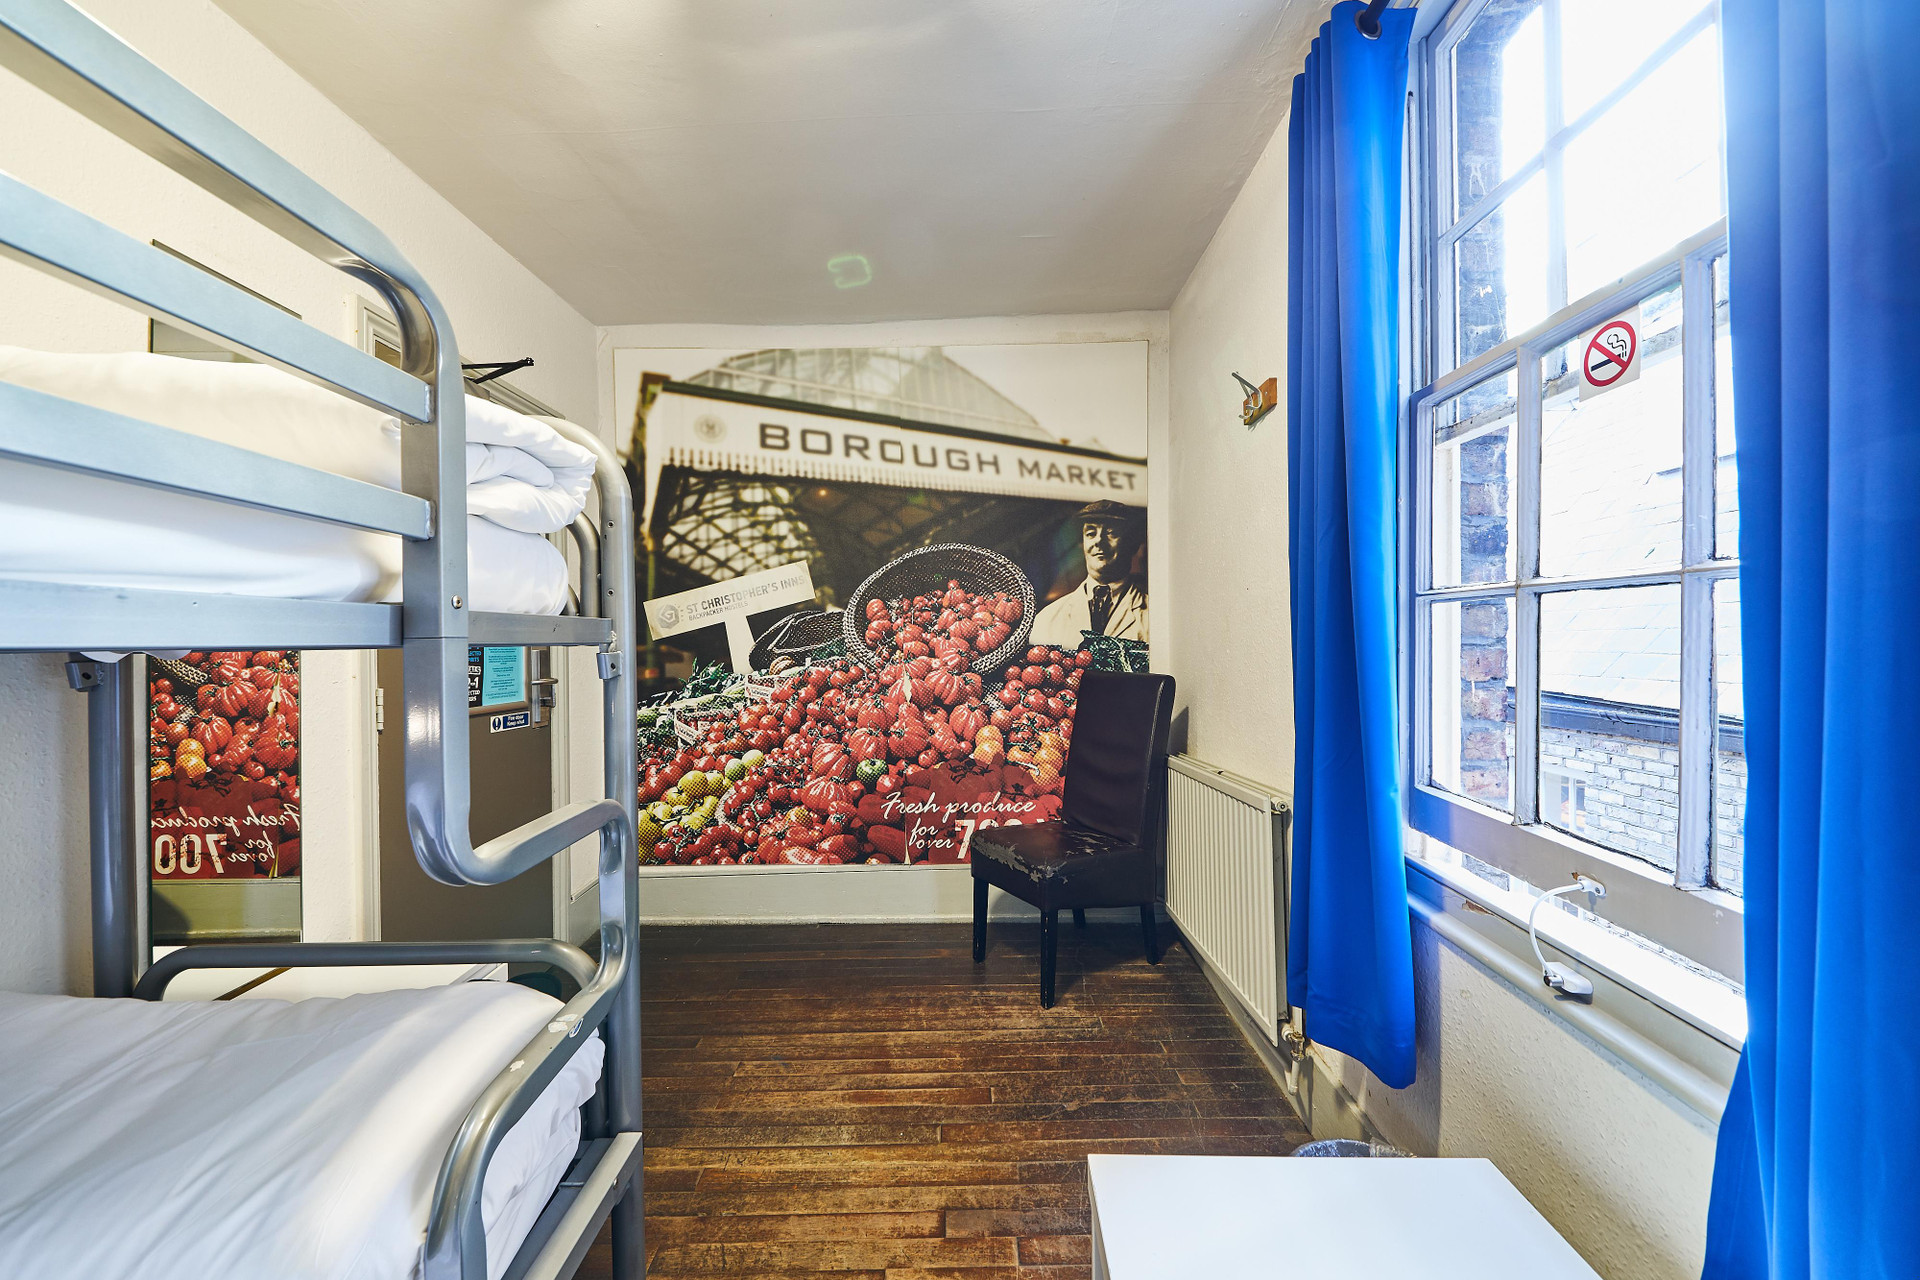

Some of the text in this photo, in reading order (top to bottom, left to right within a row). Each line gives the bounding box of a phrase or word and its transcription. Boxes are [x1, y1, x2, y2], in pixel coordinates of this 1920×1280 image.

[759, 422, 1137, 492] BOROUGH MARKET
[686, 575, 805, 614] ST CHRISTOPHER'S INNS
[688, 601, 749, 621] BACKPACKER HOSTELS
[881, 791, 1037, 823] Fresh produce
[908, 818, 938, 846] for
[915, 838, 955, 849] over
